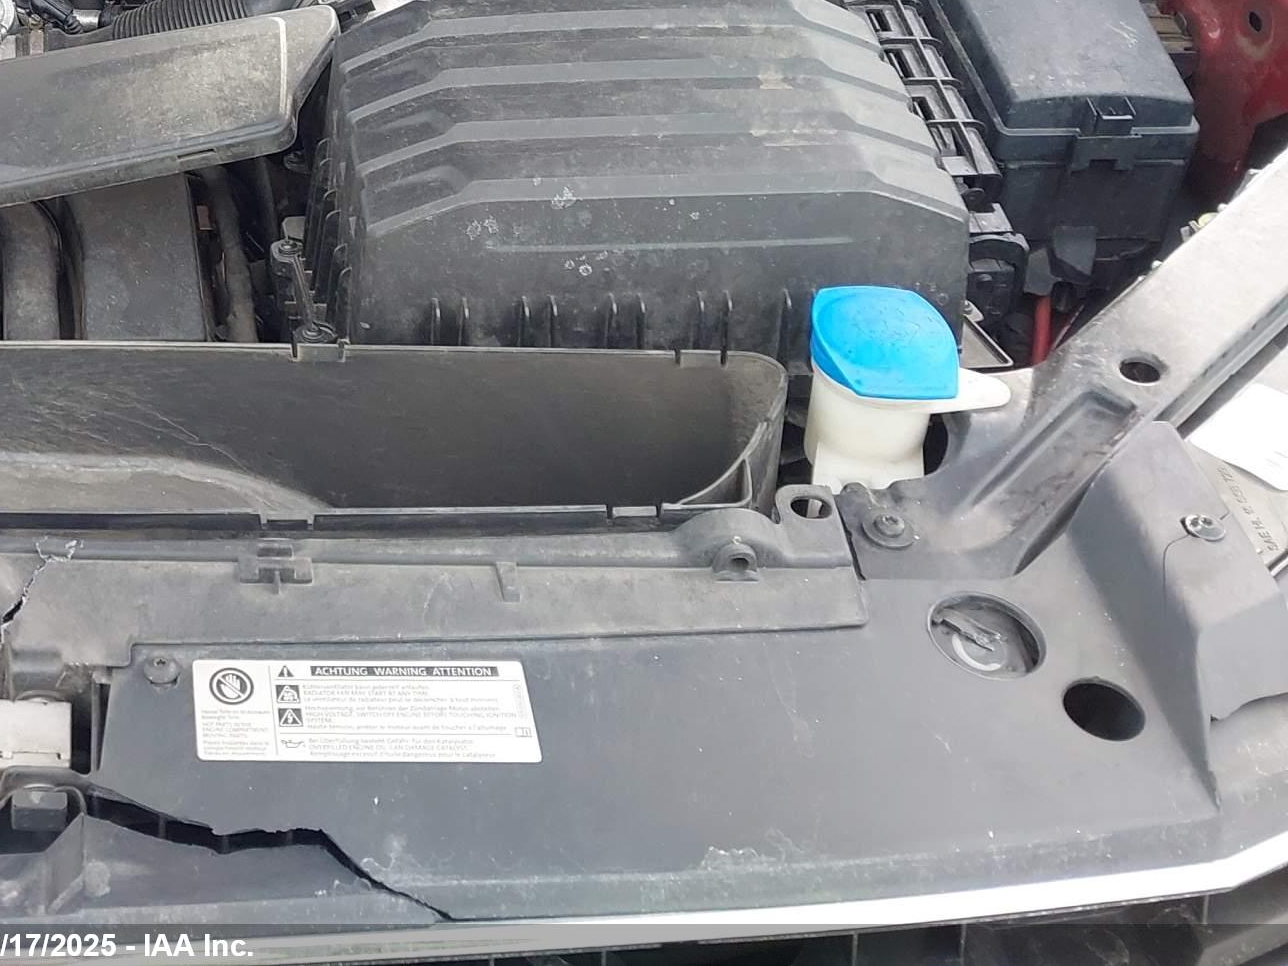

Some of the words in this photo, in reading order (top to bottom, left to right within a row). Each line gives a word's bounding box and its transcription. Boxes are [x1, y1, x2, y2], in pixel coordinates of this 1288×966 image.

[315, 666, 368, 676] ACHTUNG
[374, 666, 427, 676] WARNING
[432, 666, 492, 676] ATTENTION
